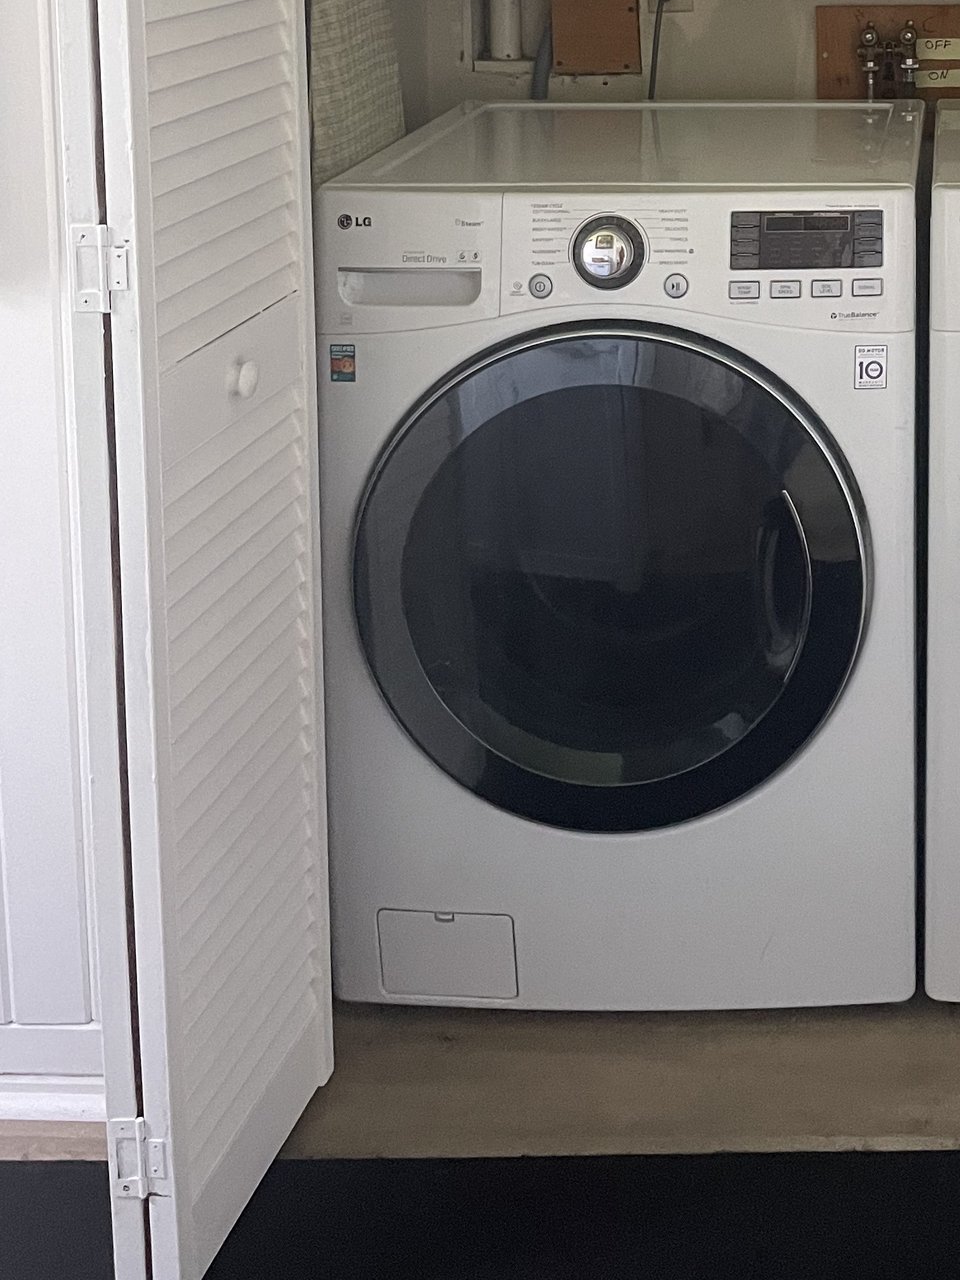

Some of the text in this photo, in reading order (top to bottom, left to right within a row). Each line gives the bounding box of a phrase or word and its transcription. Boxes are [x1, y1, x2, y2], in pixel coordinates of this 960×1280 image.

[924, 40, 952, 51] OFF
[928, 70, 950, 81] ON
[355, 216, 372, 227] LG
[402, 254, 447, 263] Direct Drive
[858, 360, 884, 380] 10
